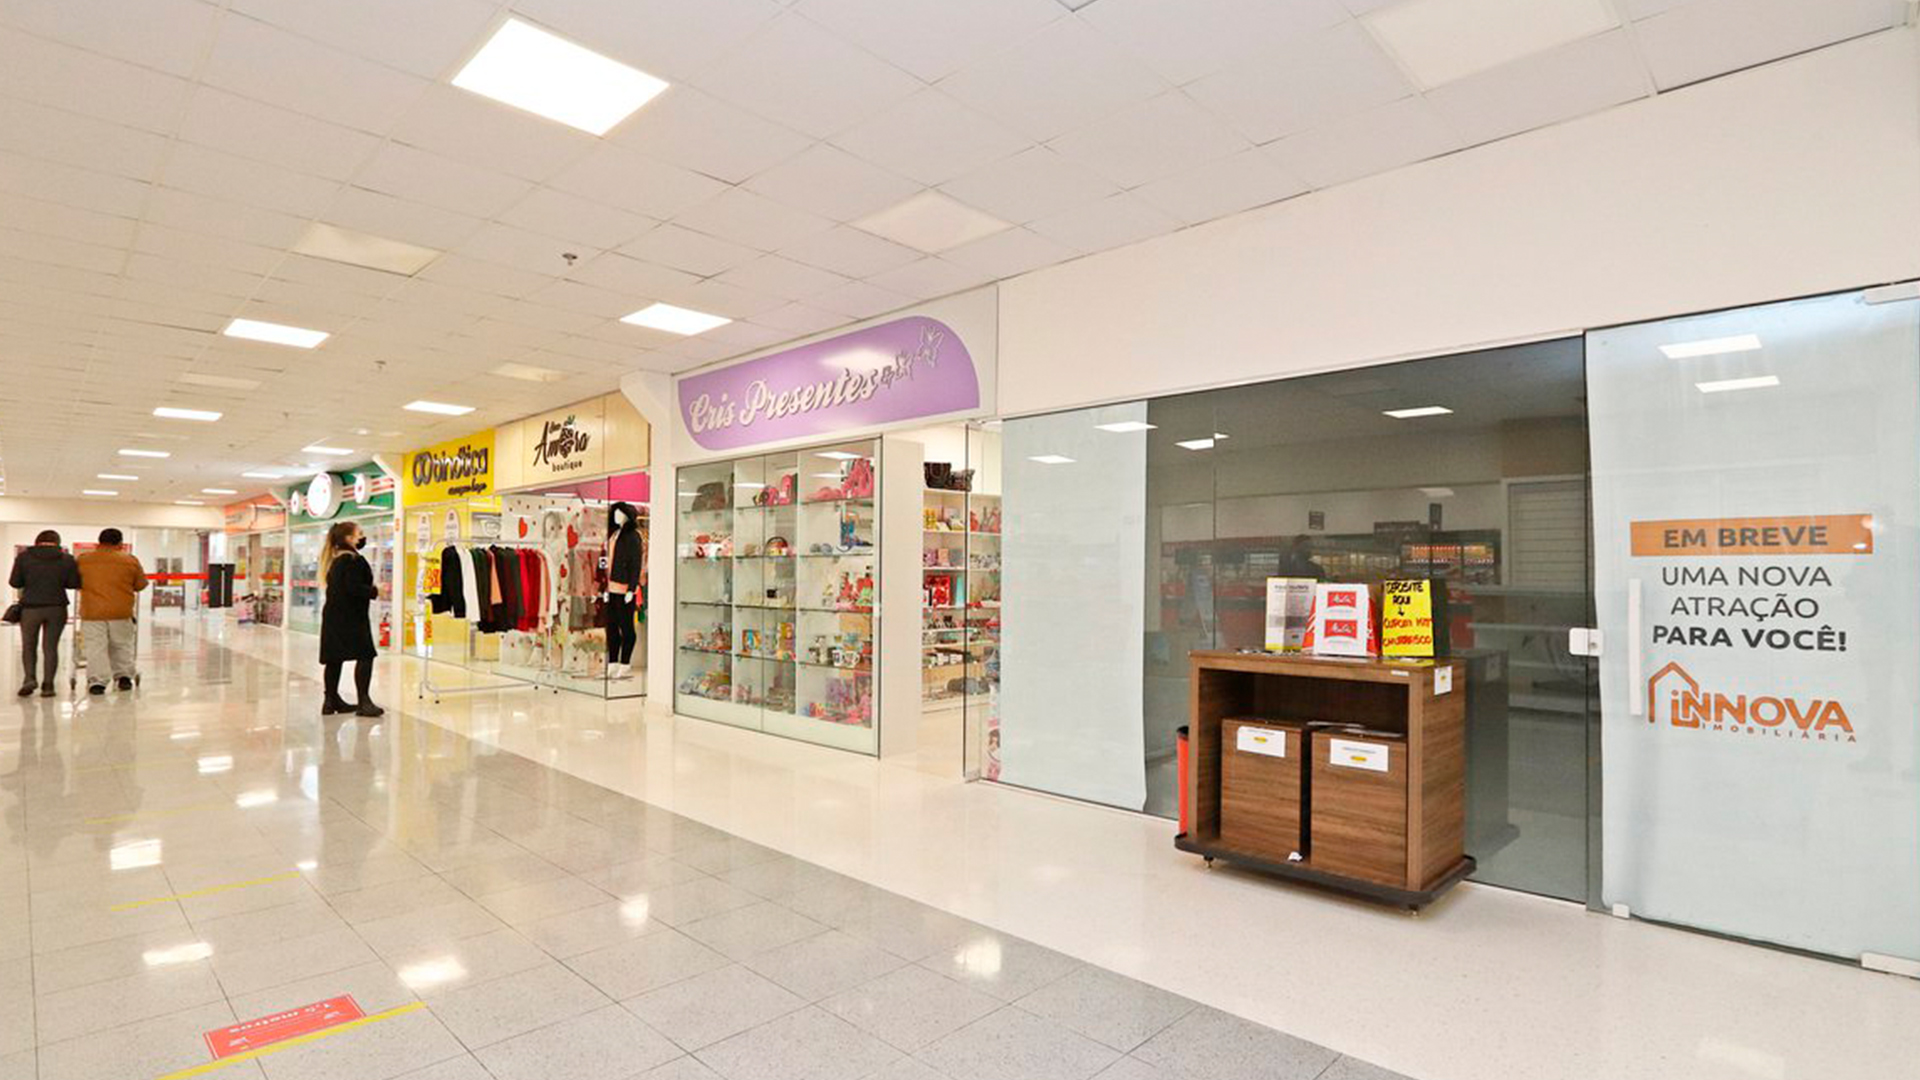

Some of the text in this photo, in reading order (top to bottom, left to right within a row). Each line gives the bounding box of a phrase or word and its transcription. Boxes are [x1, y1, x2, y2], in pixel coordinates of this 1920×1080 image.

[689, 368, 879, 434] Cris Presentes
[552, 460, 583, 472] boutique
[1664, 525, 1829, 549] EM BREVE
[1662, 566, 1832, 587] UMA NOVA
[1671, 593, 1819, 622] ATRAÇÃO
[1652, 625, 1847, 652] PARA VOCÊ!
